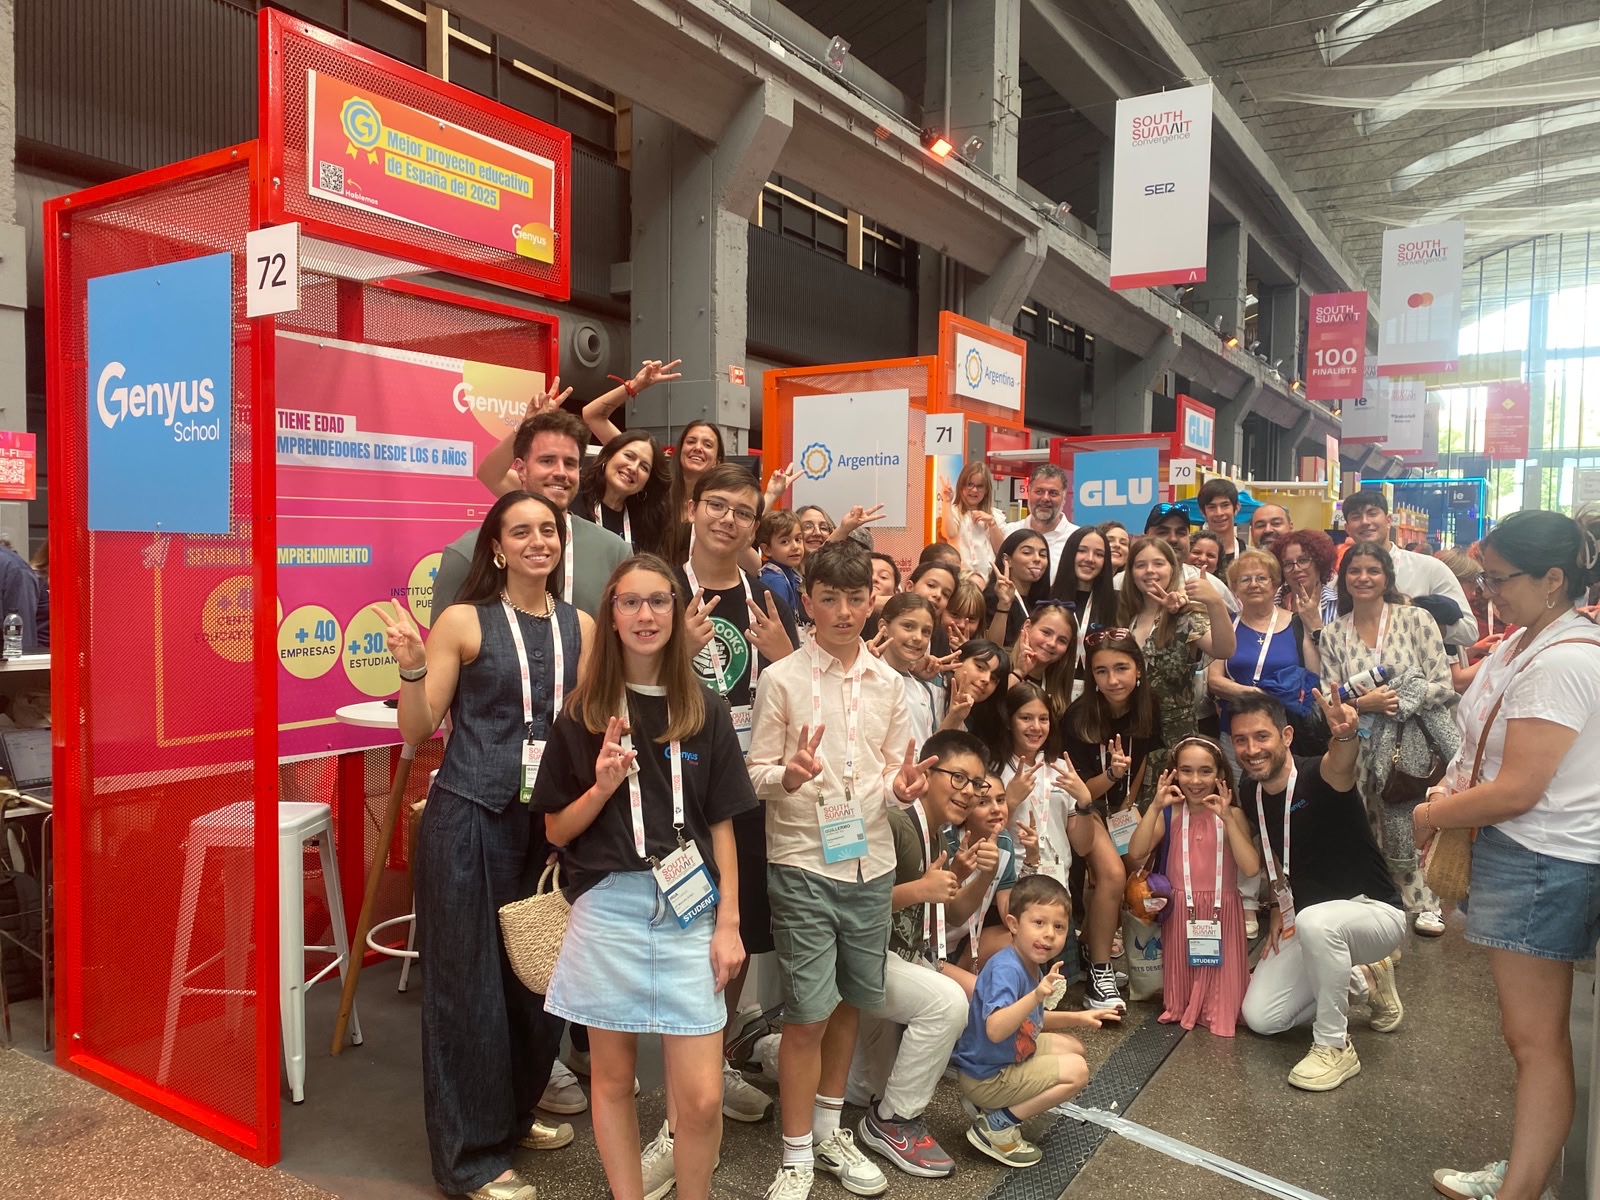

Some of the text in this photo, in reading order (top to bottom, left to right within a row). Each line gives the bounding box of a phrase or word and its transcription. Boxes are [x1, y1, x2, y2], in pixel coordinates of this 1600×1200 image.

[1132, 109, 1183, 129] SOUTH
[1131, 132, 1191, 148] convergence
[1132, 120, 1192, 141] SUMMIT
[387, 130, 530, 194] Mejor proyecto educativo
[387, 156, 497, 207] de España del 2025
[1144, 182, 1176, 196] SER
[345, 190, 379, 205] Hablemos
[511, 223, 547, 246] Genyus
[1397, 247, 1449, 262] SUMMIT
[1398, 239, 1441, 253] SOUTH
[257, 253, 287, 290] 72
[1315, 304, 1354, 315] SOUTH
[1315, 311, 1361, 324] SUMMIT
[1314, 347, 1358, 367] 100
[984, 366, 1015, 388] Argentina
[1312, 366, 1357, 376] FINALISTS
[96, 361, 215, 430] Genyus
[452, 382, 528, 419] Genyus
[173, 417, 220, 442] School
[277, 410, 345, 434] TIENE EDAD
[1188, 414, 1211, 449] GLU
[936, 426, 952, 443] 71
[0, 448, 18, 458] I-FI
[276, 436, 467, 467] MPRENDEDORES DESDE LOS 6 AÑOS
[838, 452, 900, 470] Argentina
[1175, 466, 1191, 478] 70
[1079, 477, 1153, 507] GLU
[276, 547, 369, 565] MPRENDIMIENTO
[390, 586, 433, 597] INSTITUC
[314, 619, 336, 643] 40
[280, 645, 336, 660] EMPRESAS
[732, 711, 750, 719] OUTH
[824, 803, 850, 812] SOUTH
[661, 854, 688, 875] SOUTH
[683, 894, 715, 922] STUDENT
